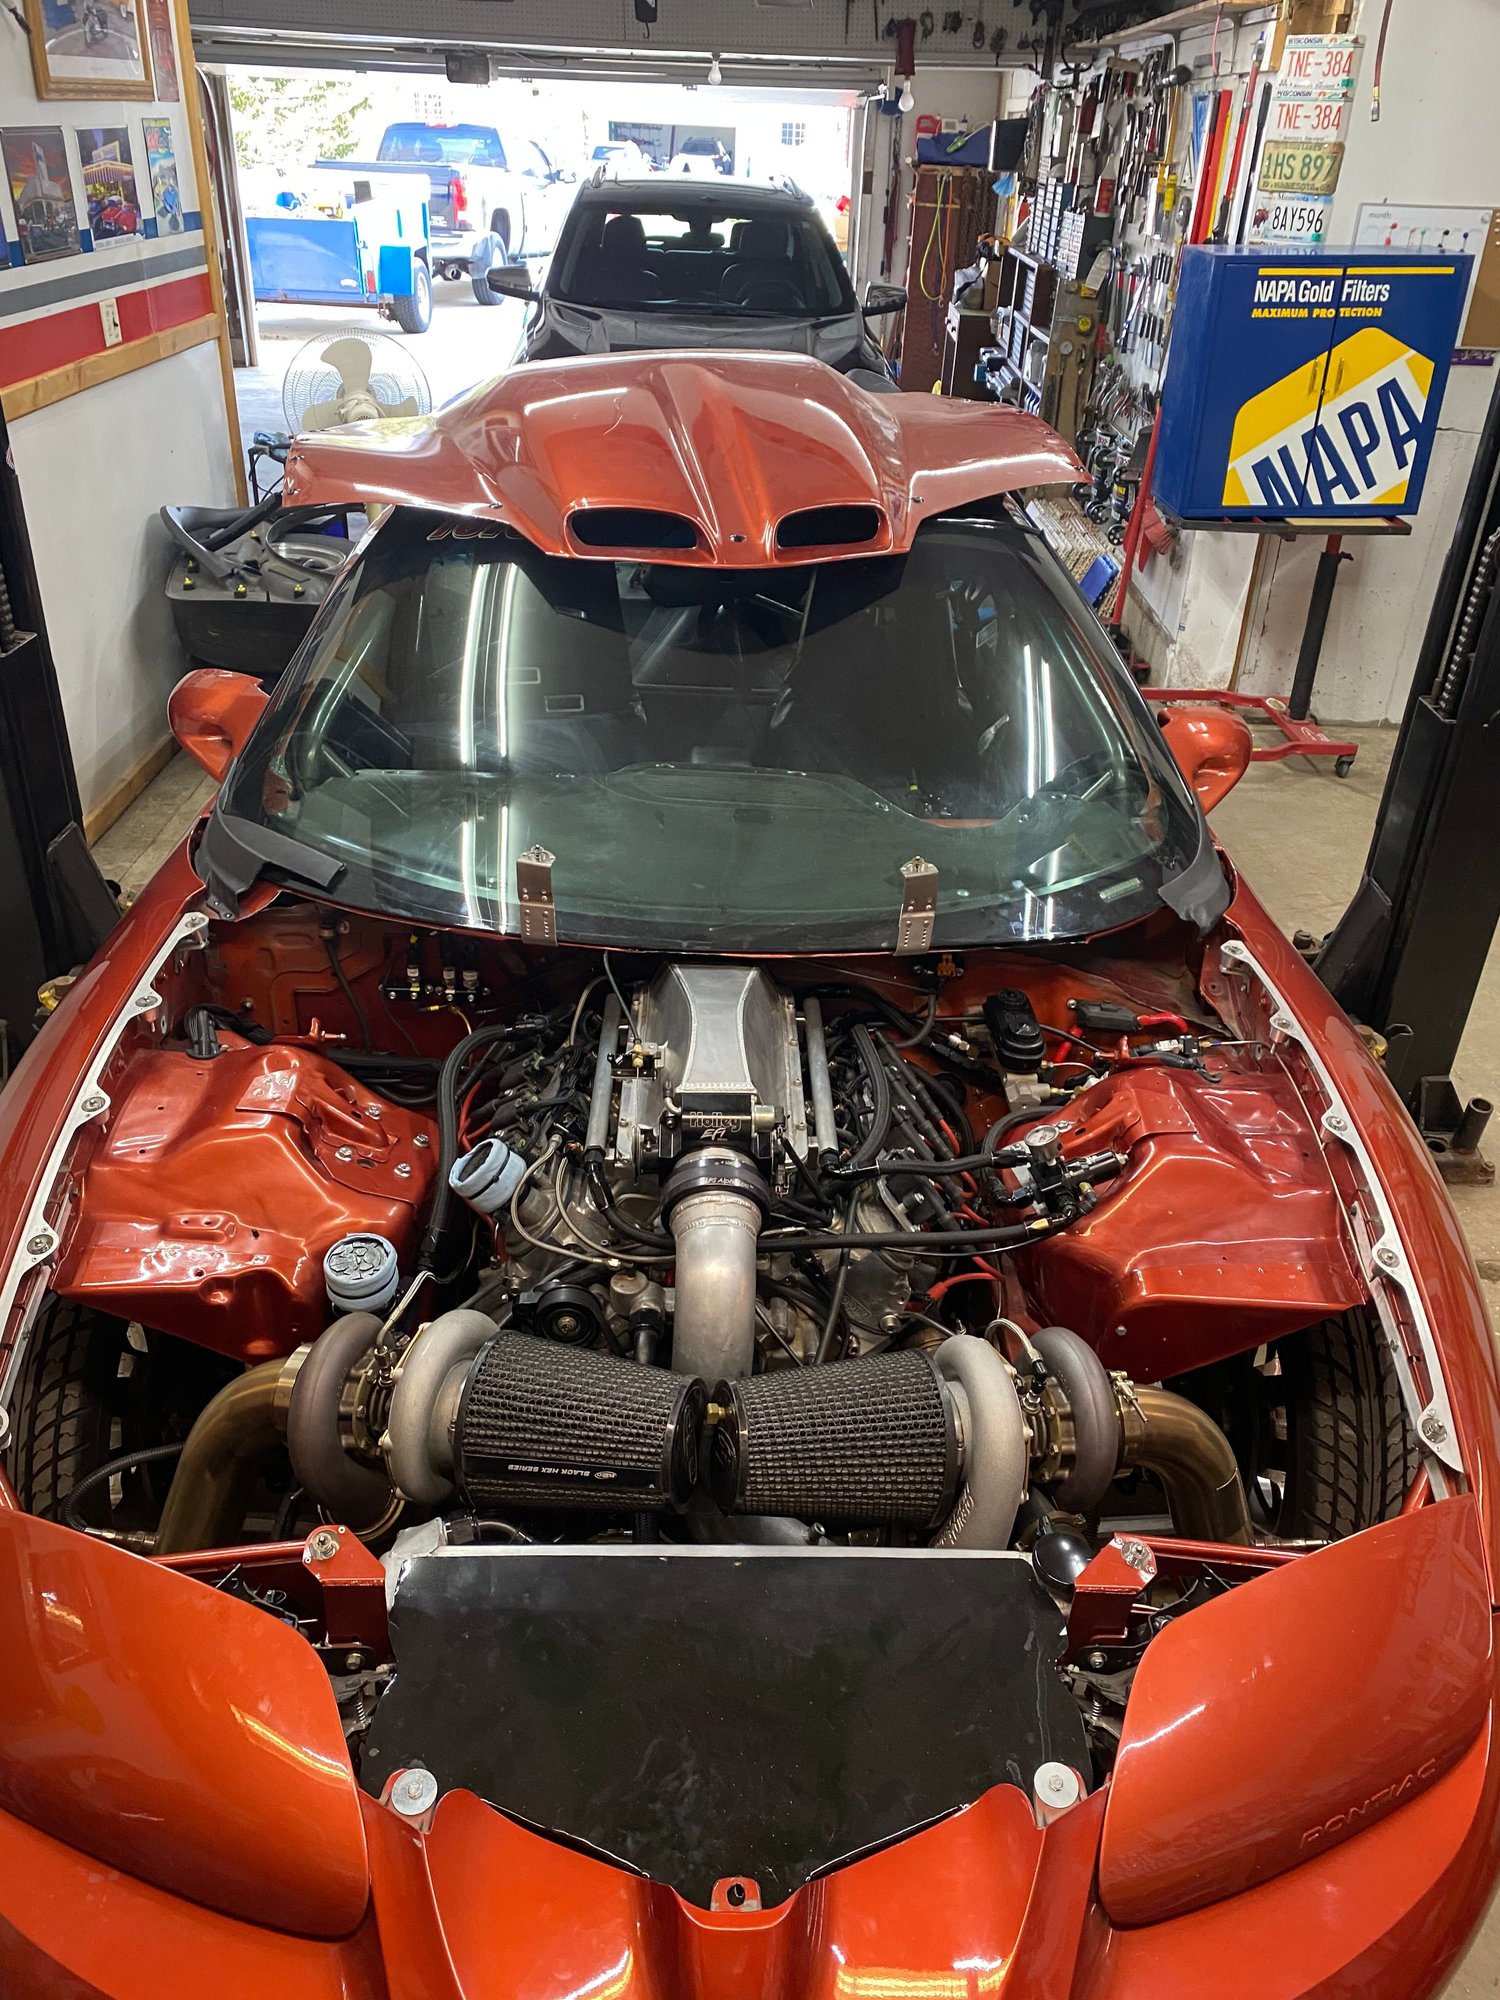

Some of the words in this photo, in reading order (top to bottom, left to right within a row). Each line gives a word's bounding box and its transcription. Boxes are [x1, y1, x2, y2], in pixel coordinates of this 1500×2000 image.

[1287, 51, 1354, 77] TNE-384
[1277, 103, 1343, 130] TNE-384
[1263, 153, 1296, 180] 1HS
[1299, 154, 1339, 182] 897
[1272, 206, 1324, 233] 8AY596
[1253, 279, 1296, 303] NAPA
[1298, 279, 1335, 303] Gold
[1341, 279, 1391, 302] Filters
[1251, 307, 1309, 318] MAXIMUM
[1312, 307, 1383, 318] PROTECTION
[1252, 377, 1423, 507] NAPA
[689, 1111, 742, 1133] Holley
[507, 1463, 539, 1473] SERIES
[560, 1468, 591, 1477] BLACK
[1300, 1758, 1436, 1850] PONTIAC
